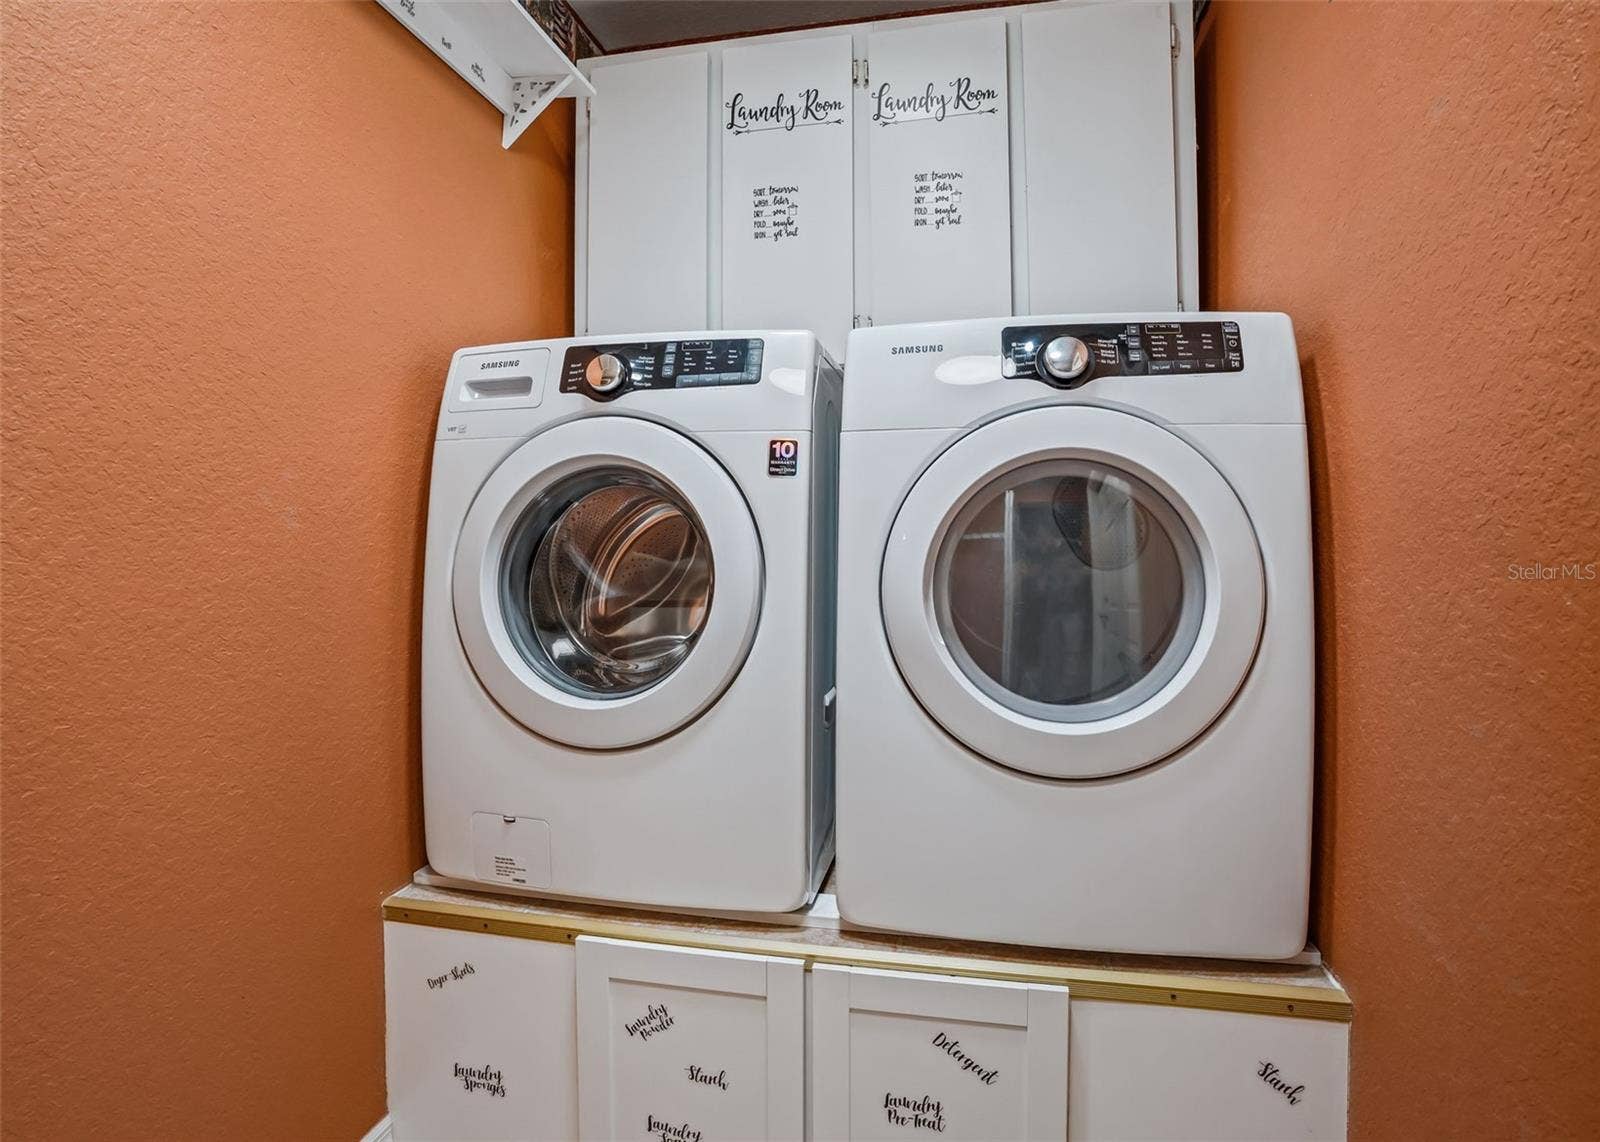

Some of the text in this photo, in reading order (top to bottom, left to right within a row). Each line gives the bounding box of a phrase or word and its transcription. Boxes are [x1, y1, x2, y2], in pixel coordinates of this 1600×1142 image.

[725, 89, 844, 131] Laundry Room
[872, 77, 998, 121] Laundry Room
[891, 344, 943, 355] SAMSUNG
[481, 360, 520, 370] SAMSUNG
[772, 441, 795, 458] 10
[625, 1004, 669, 1036] Laundry
[639, 1015, 674, 1041] Powder
[932, 1032, 999, 1085] Detergent
[454, 1062, 502, 1085] Laundry
[462, 1076, 506, 1097] Sponges
[684, 1064, 730, 1091] Starch
[1257, 1061, 1305, 1106] Starch
[884, 1092, 943, 1118] Laundry
[648, 1114, 703, 1142] Laundry
[888, 1109, 946, 1133] Pre-Treat
